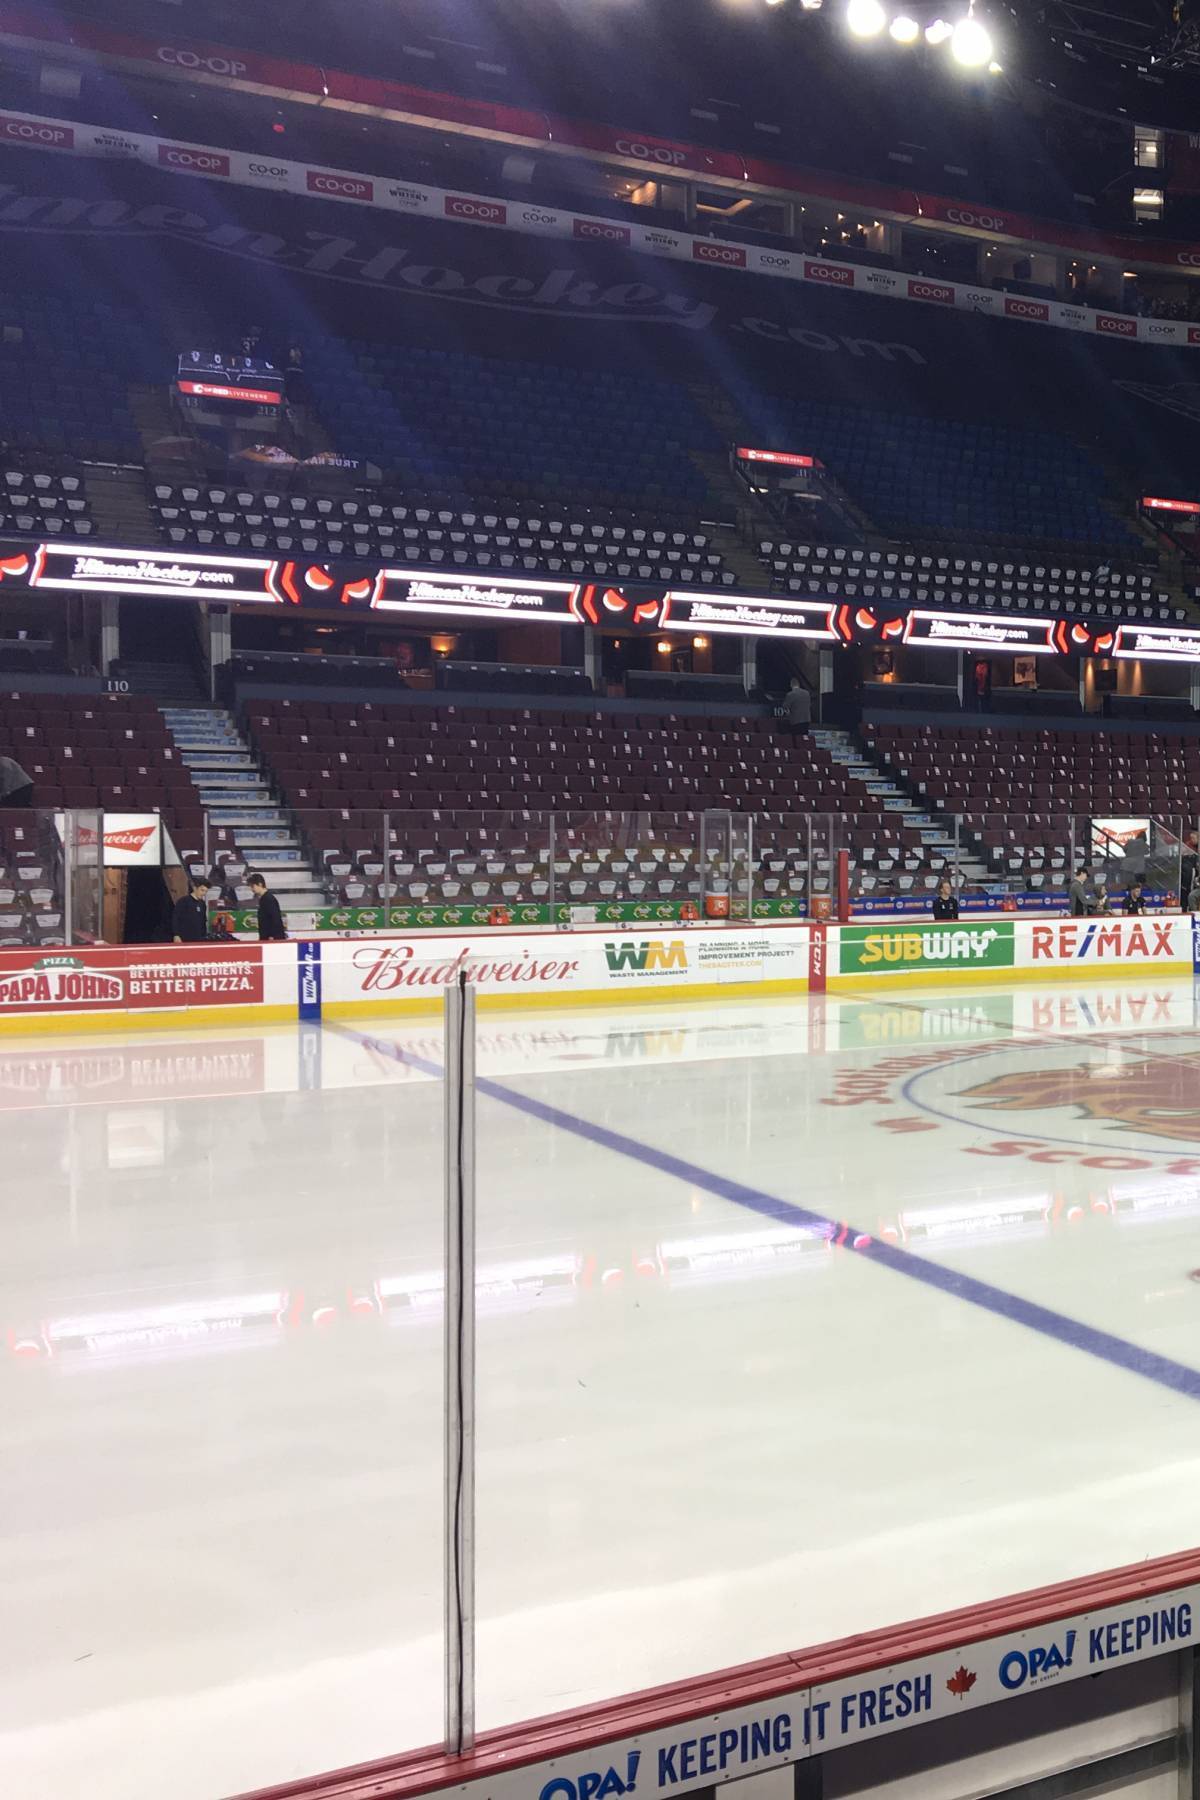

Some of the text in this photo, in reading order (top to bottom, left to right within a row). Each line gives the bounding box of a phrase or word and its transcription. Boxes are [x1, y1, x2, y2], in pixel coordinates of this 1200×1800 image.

[107, 680, 129, 692] 110
[604, 940, 688, 971] WM
[859, 928, 999, 965] SUBWAY
[1032, 922, 1175, 959] RE/MAX
[42, 957, 75, 966] PIZZA
[129, 964, 174, 979] BETTER
[352, 946, 580, 991] Budweiser
[636, 969, 688, 977] MANAGEMENT
[0, 974, 52, 1003] PAPA
[129, 977, 254, 995] BETTER PIZZA.
[998, 1630, 1077, 1690] OPA!
[1088, 1602, 1192, 1664] KEEPING
[657, 1712, 792, 1787] KEEPING
[802, 1706, 831, 1744] IT
[840, 1673, 934, 1735] FRESH
